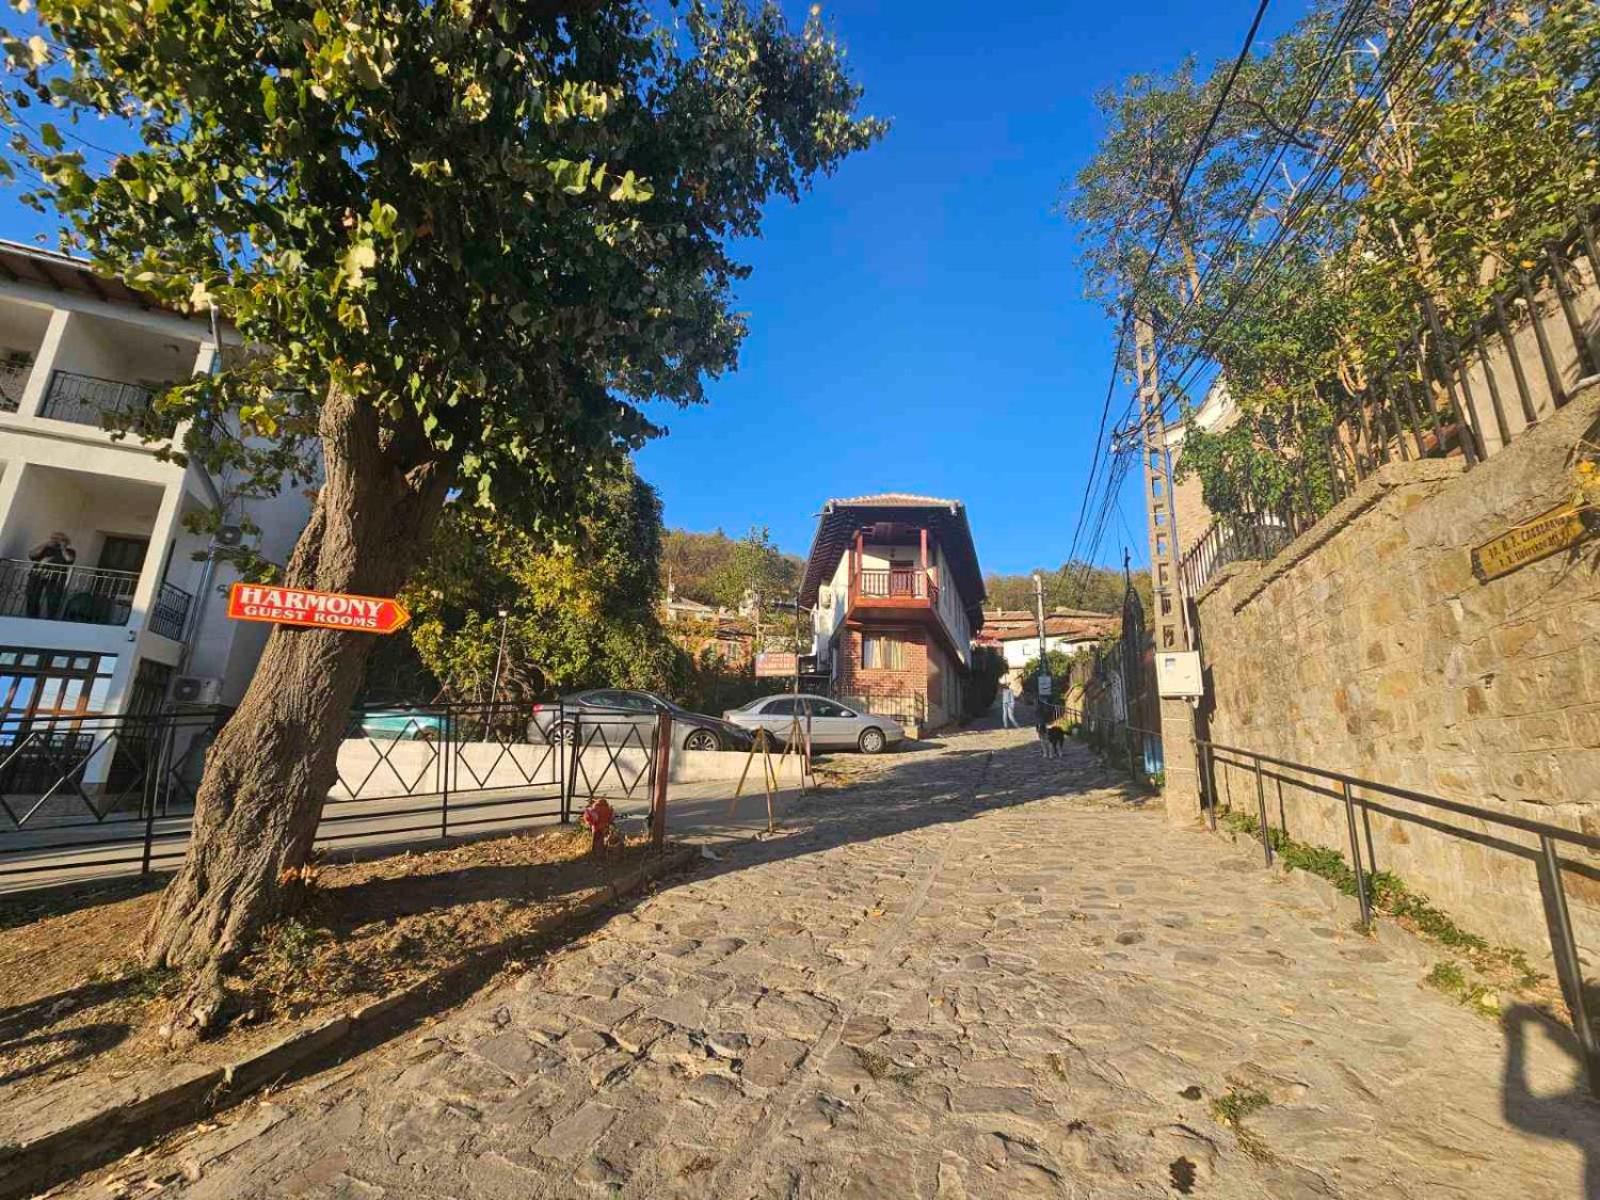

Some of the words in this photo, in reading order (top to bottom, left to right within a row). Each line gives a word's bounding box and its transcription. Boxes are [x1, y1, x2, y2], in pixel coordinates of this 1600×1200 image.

[241, 587, 384, 617] HARMONY
[244, 605, 306, 620] GUEST
[314, 613, 377, 627] ROOMS
